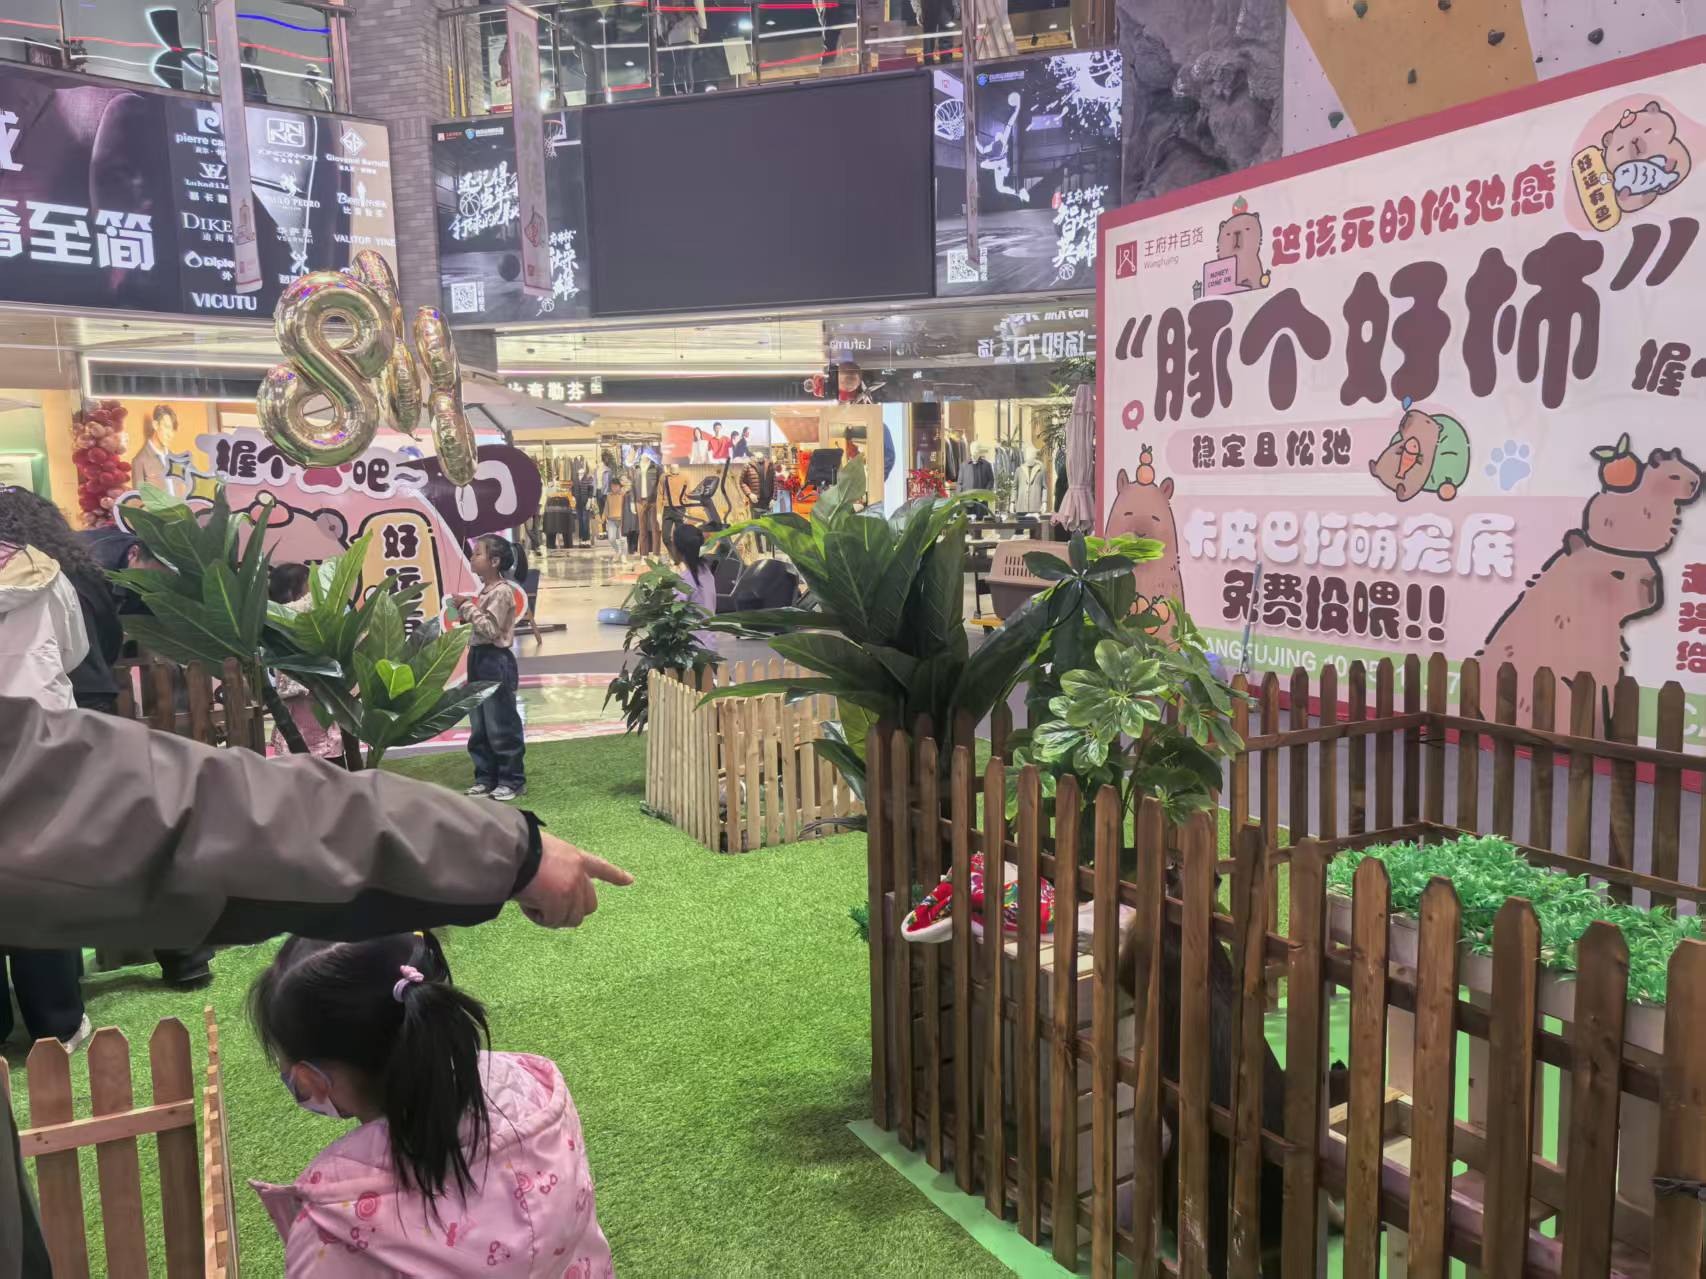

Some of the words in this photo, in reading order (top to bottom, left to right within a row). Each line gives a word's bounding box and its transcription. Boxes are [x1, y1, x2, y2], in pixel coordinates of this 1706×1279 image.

[1144, 226, 1204, 257] 王府井百货
[191, 292, 257, 310] VICUTU
[1631, 338, 1706, 397] 握
[1192, 428, 1352, 468] 稳定且松弛
[1184, 509, 1516, 578] 卡皮巴拉萌宠展
[1223, 569, 1446, 641] 免费投喂!!
